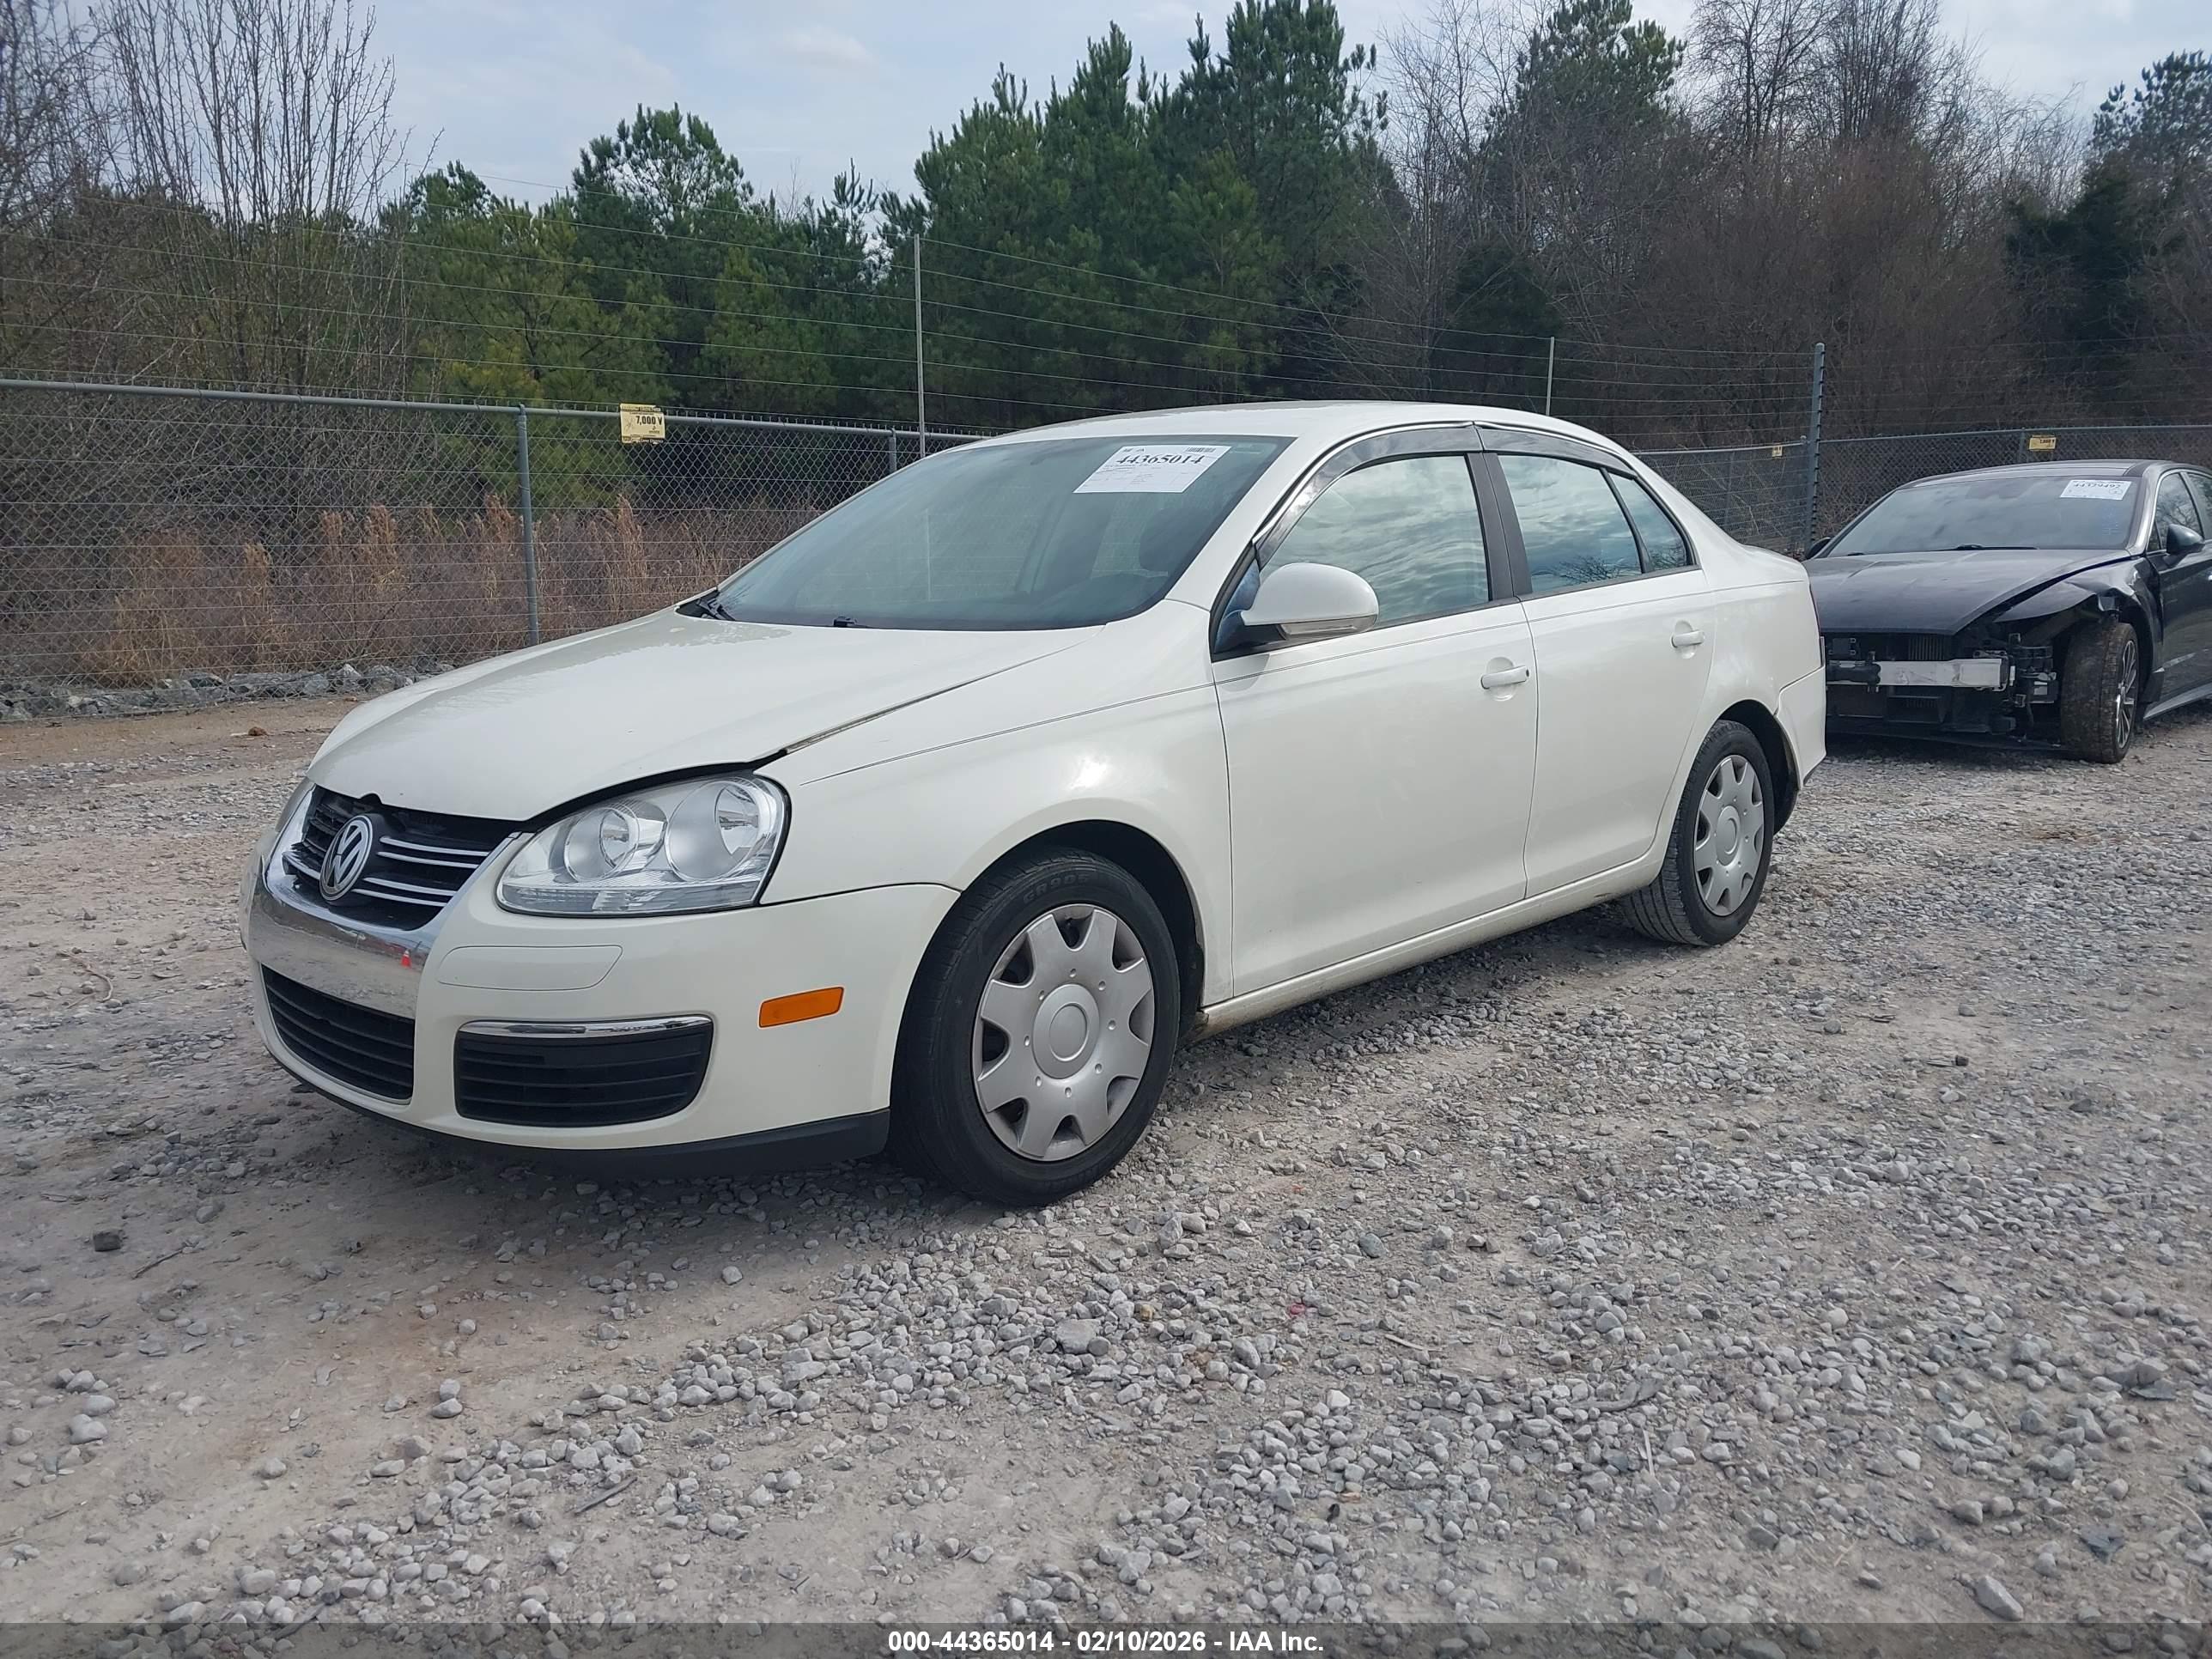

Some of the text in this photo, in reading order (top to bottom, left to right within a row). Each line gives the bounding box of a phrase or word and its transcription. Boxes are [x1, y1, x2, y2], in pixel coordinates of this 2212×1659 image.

[635, 416, 663, 426] 7,000 V
[1116, 454, 1206, 465] 44365014
